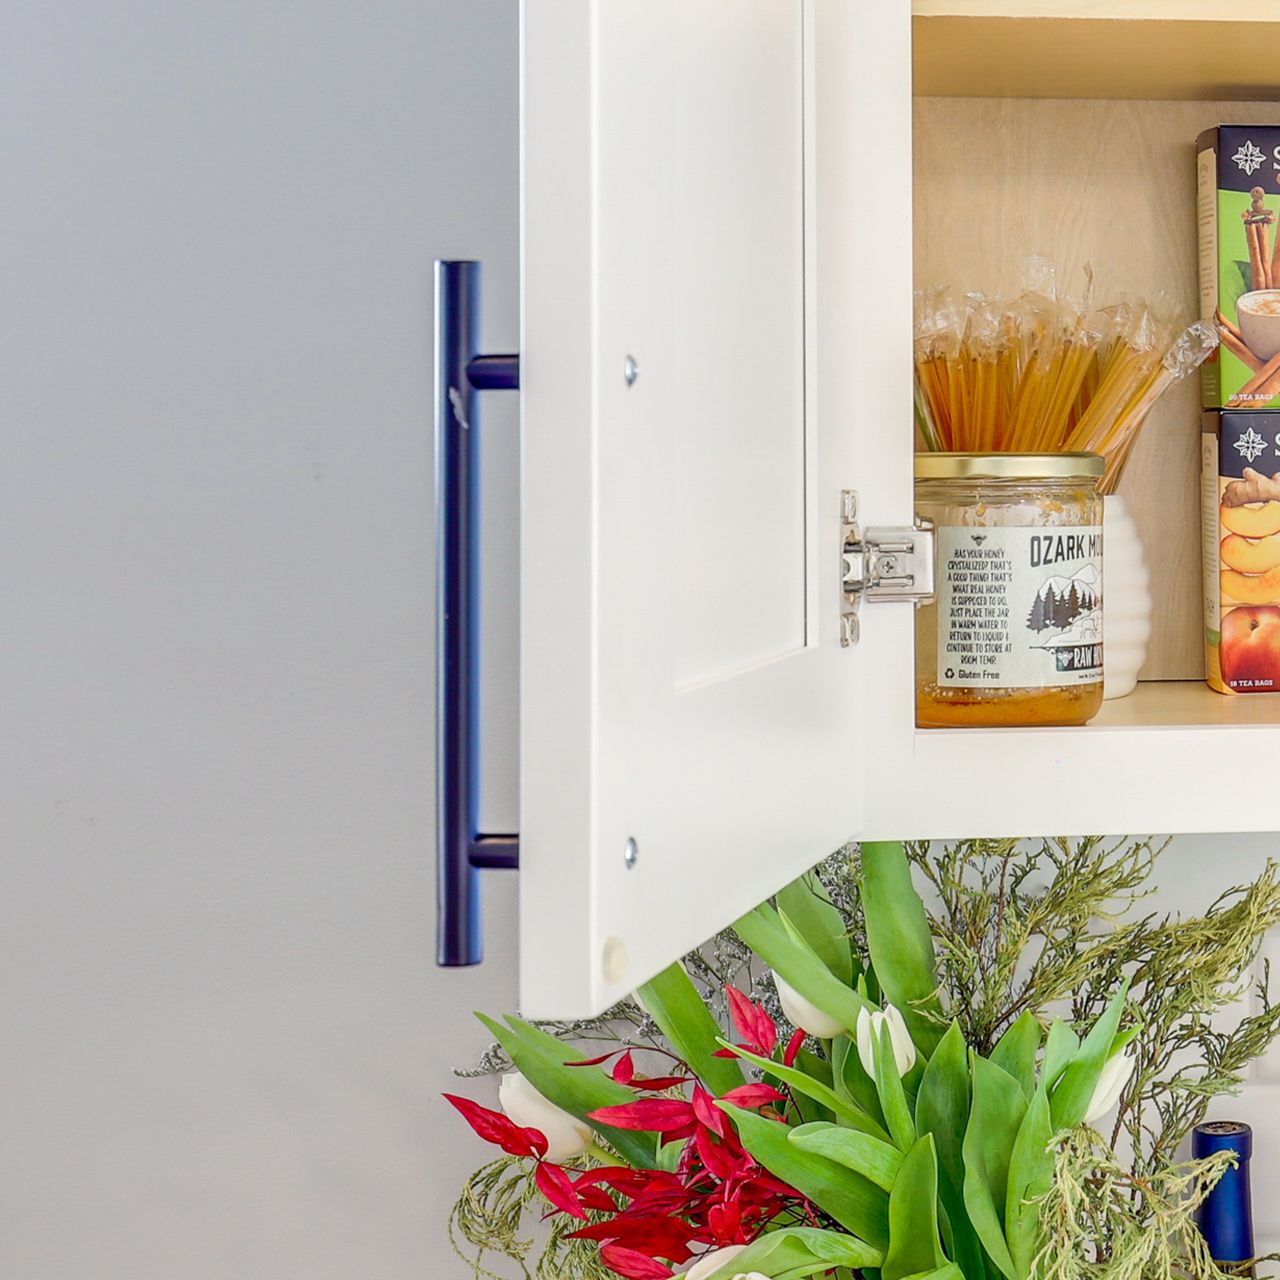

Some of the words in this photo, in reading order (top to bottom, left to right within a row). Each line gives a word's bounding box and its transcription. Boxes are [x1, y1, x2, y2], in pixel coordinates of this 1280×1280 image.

[967, 549, 983, 558] YOUR
[984, 548, 1005, 558] HONEY
[1030, 534, 1085, 568] OZARK
[948, 561, 988, 570] CRYSTALIZED?
[990, 561, 1012, 570] THAT'S
[953, 573, 968, 581] GOOD
[991, 573, 1012, 582] THAT'S
[953, 584, 969, 593] WHAT
[970, 584, 984, 594] REAL
[986, 584, 1006, 594] HONEY
[958, 597, 987, 605] SUPPOSED
[989, 597, 996, 605] TO
[950, 608, 963, 617] JUST
[965, 608, 982, 617] PLACE
[984, 608, 995, 617] THE
[997, 608, 1009, 617] JAR
[951, 620, 956, 629] IN
[958, 620, 976, 629] WARM
[978, 620, 999, 629] WATER
[950, 631, 971, 641] RETURN
[973, 631, 981, 641] TO
[982, 632, 1004, 642] LIQUID
[946, 643, 973, 652] CONTINUE
[975, 643, 983, 652] TO
[985, 643, 1002, 652] STORE
[1004, 643, 1012, 652] AT
[961, 655, 977, 664] ROOM
[1074, 647, 1093, 668] RAW
[959, 670, 981, 679] Gluten
[983, 670, 1000, 679] Free
